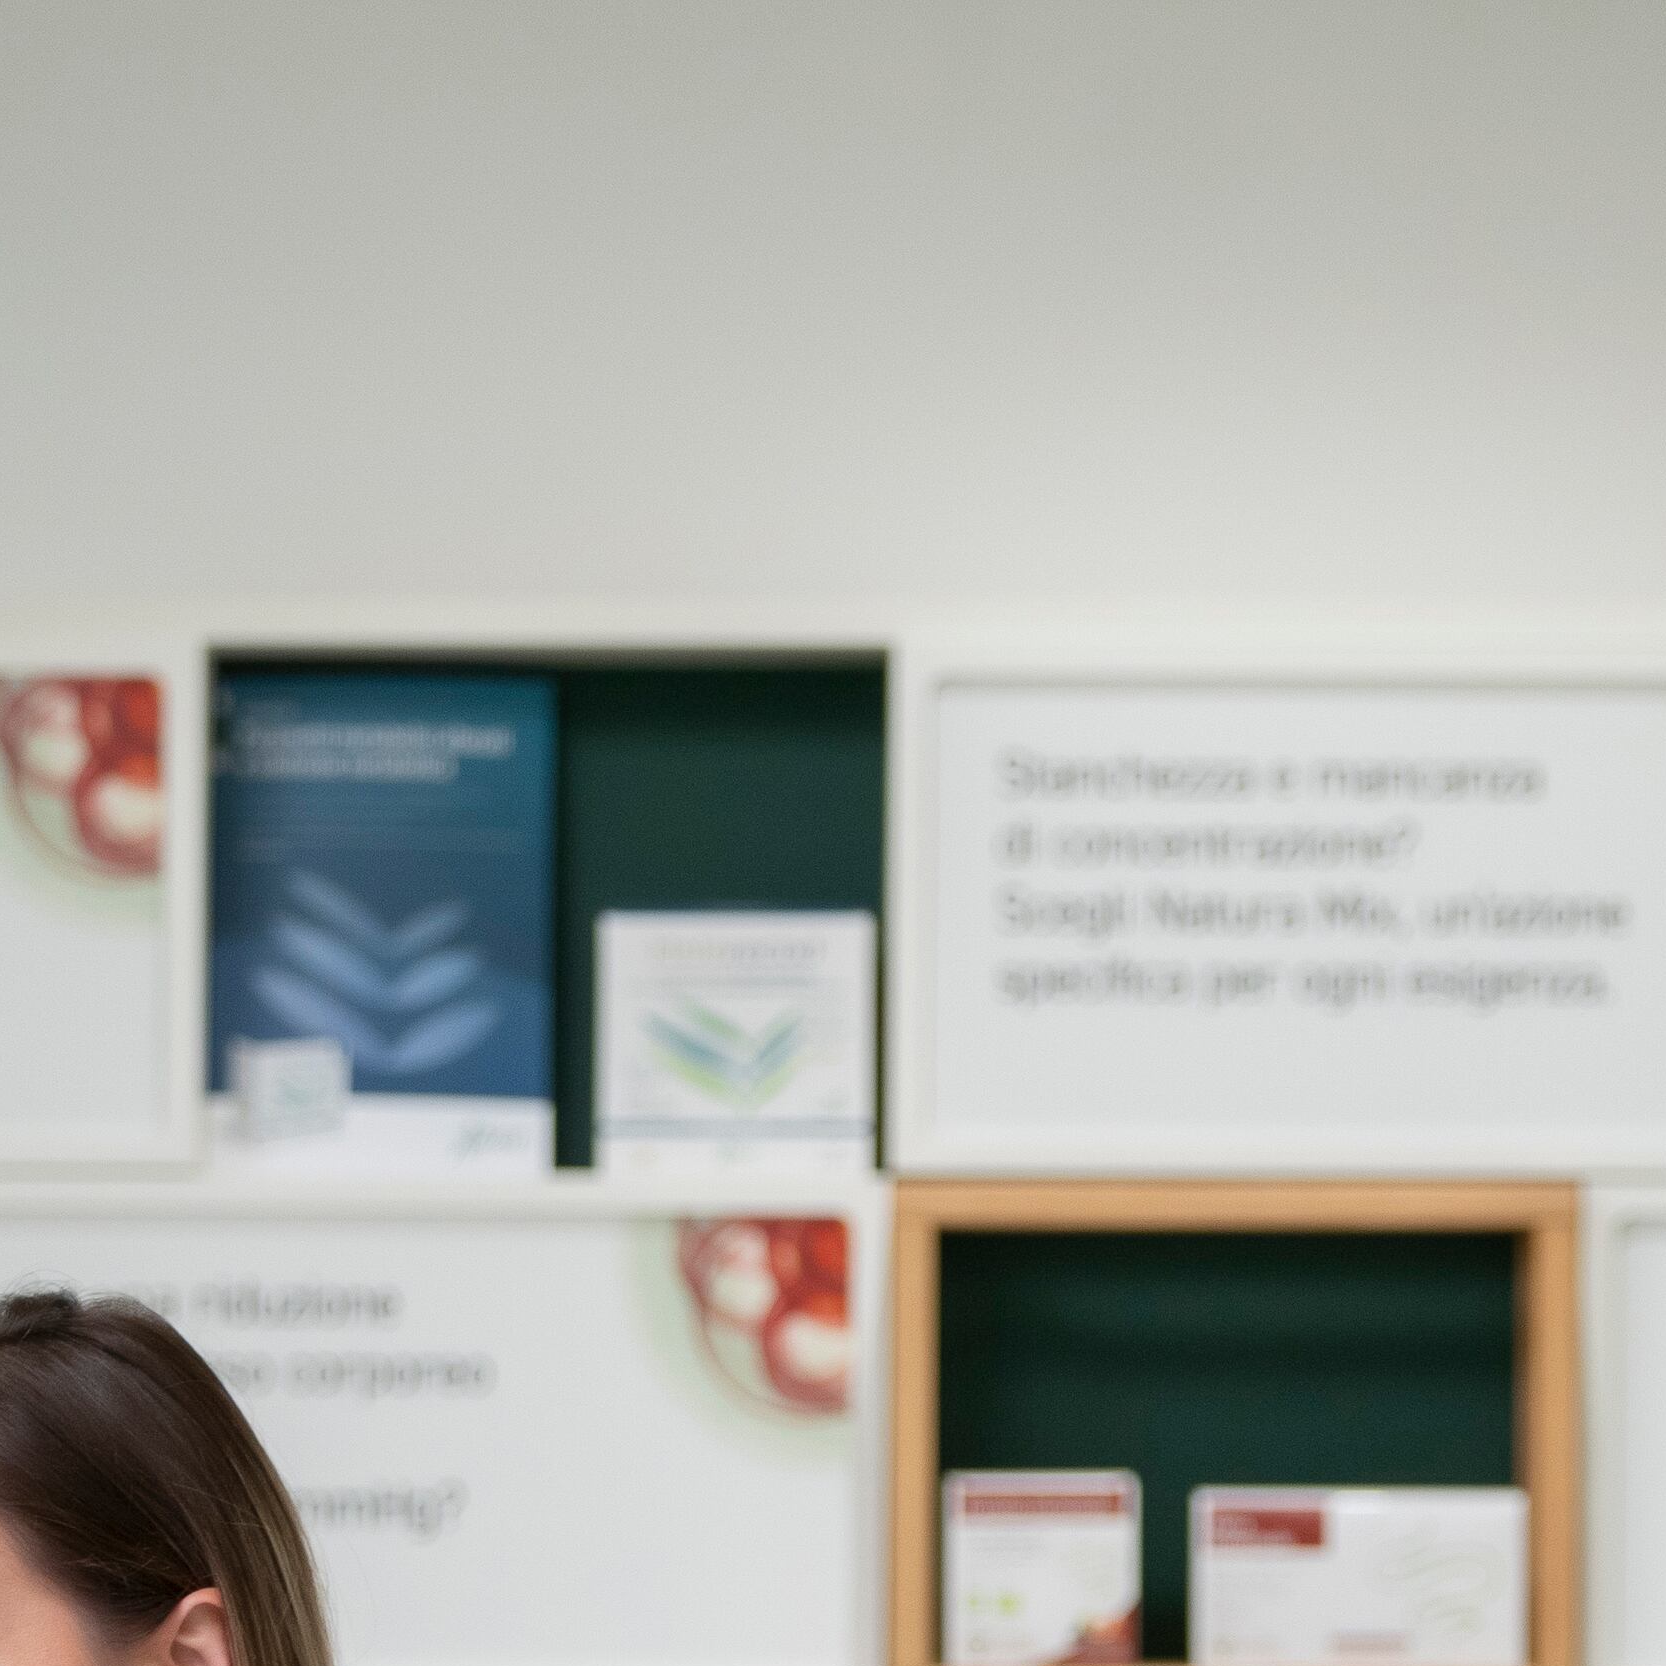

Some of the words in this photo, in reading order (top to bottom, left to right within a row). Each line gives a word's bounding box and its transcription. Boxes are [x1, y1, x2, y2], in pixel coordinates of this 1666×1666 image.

[993, 744, 1256, 802] Stanchezza
[1315, 756, 1547, 802] mancanza
[995, 815, 1033, 868] di
[1049, 815, 1421, 868] concentrazione?
[994, 883, 1125, 941] Scegli
[1145, 883, 1303, 936] Natura
[994, 956, 1190, 1014] specifica
[1201, 964, 1279, 1014] per
[1292, 960, 1387, 1016] ogni
[192, 1276, 401, 1327] riduzione
